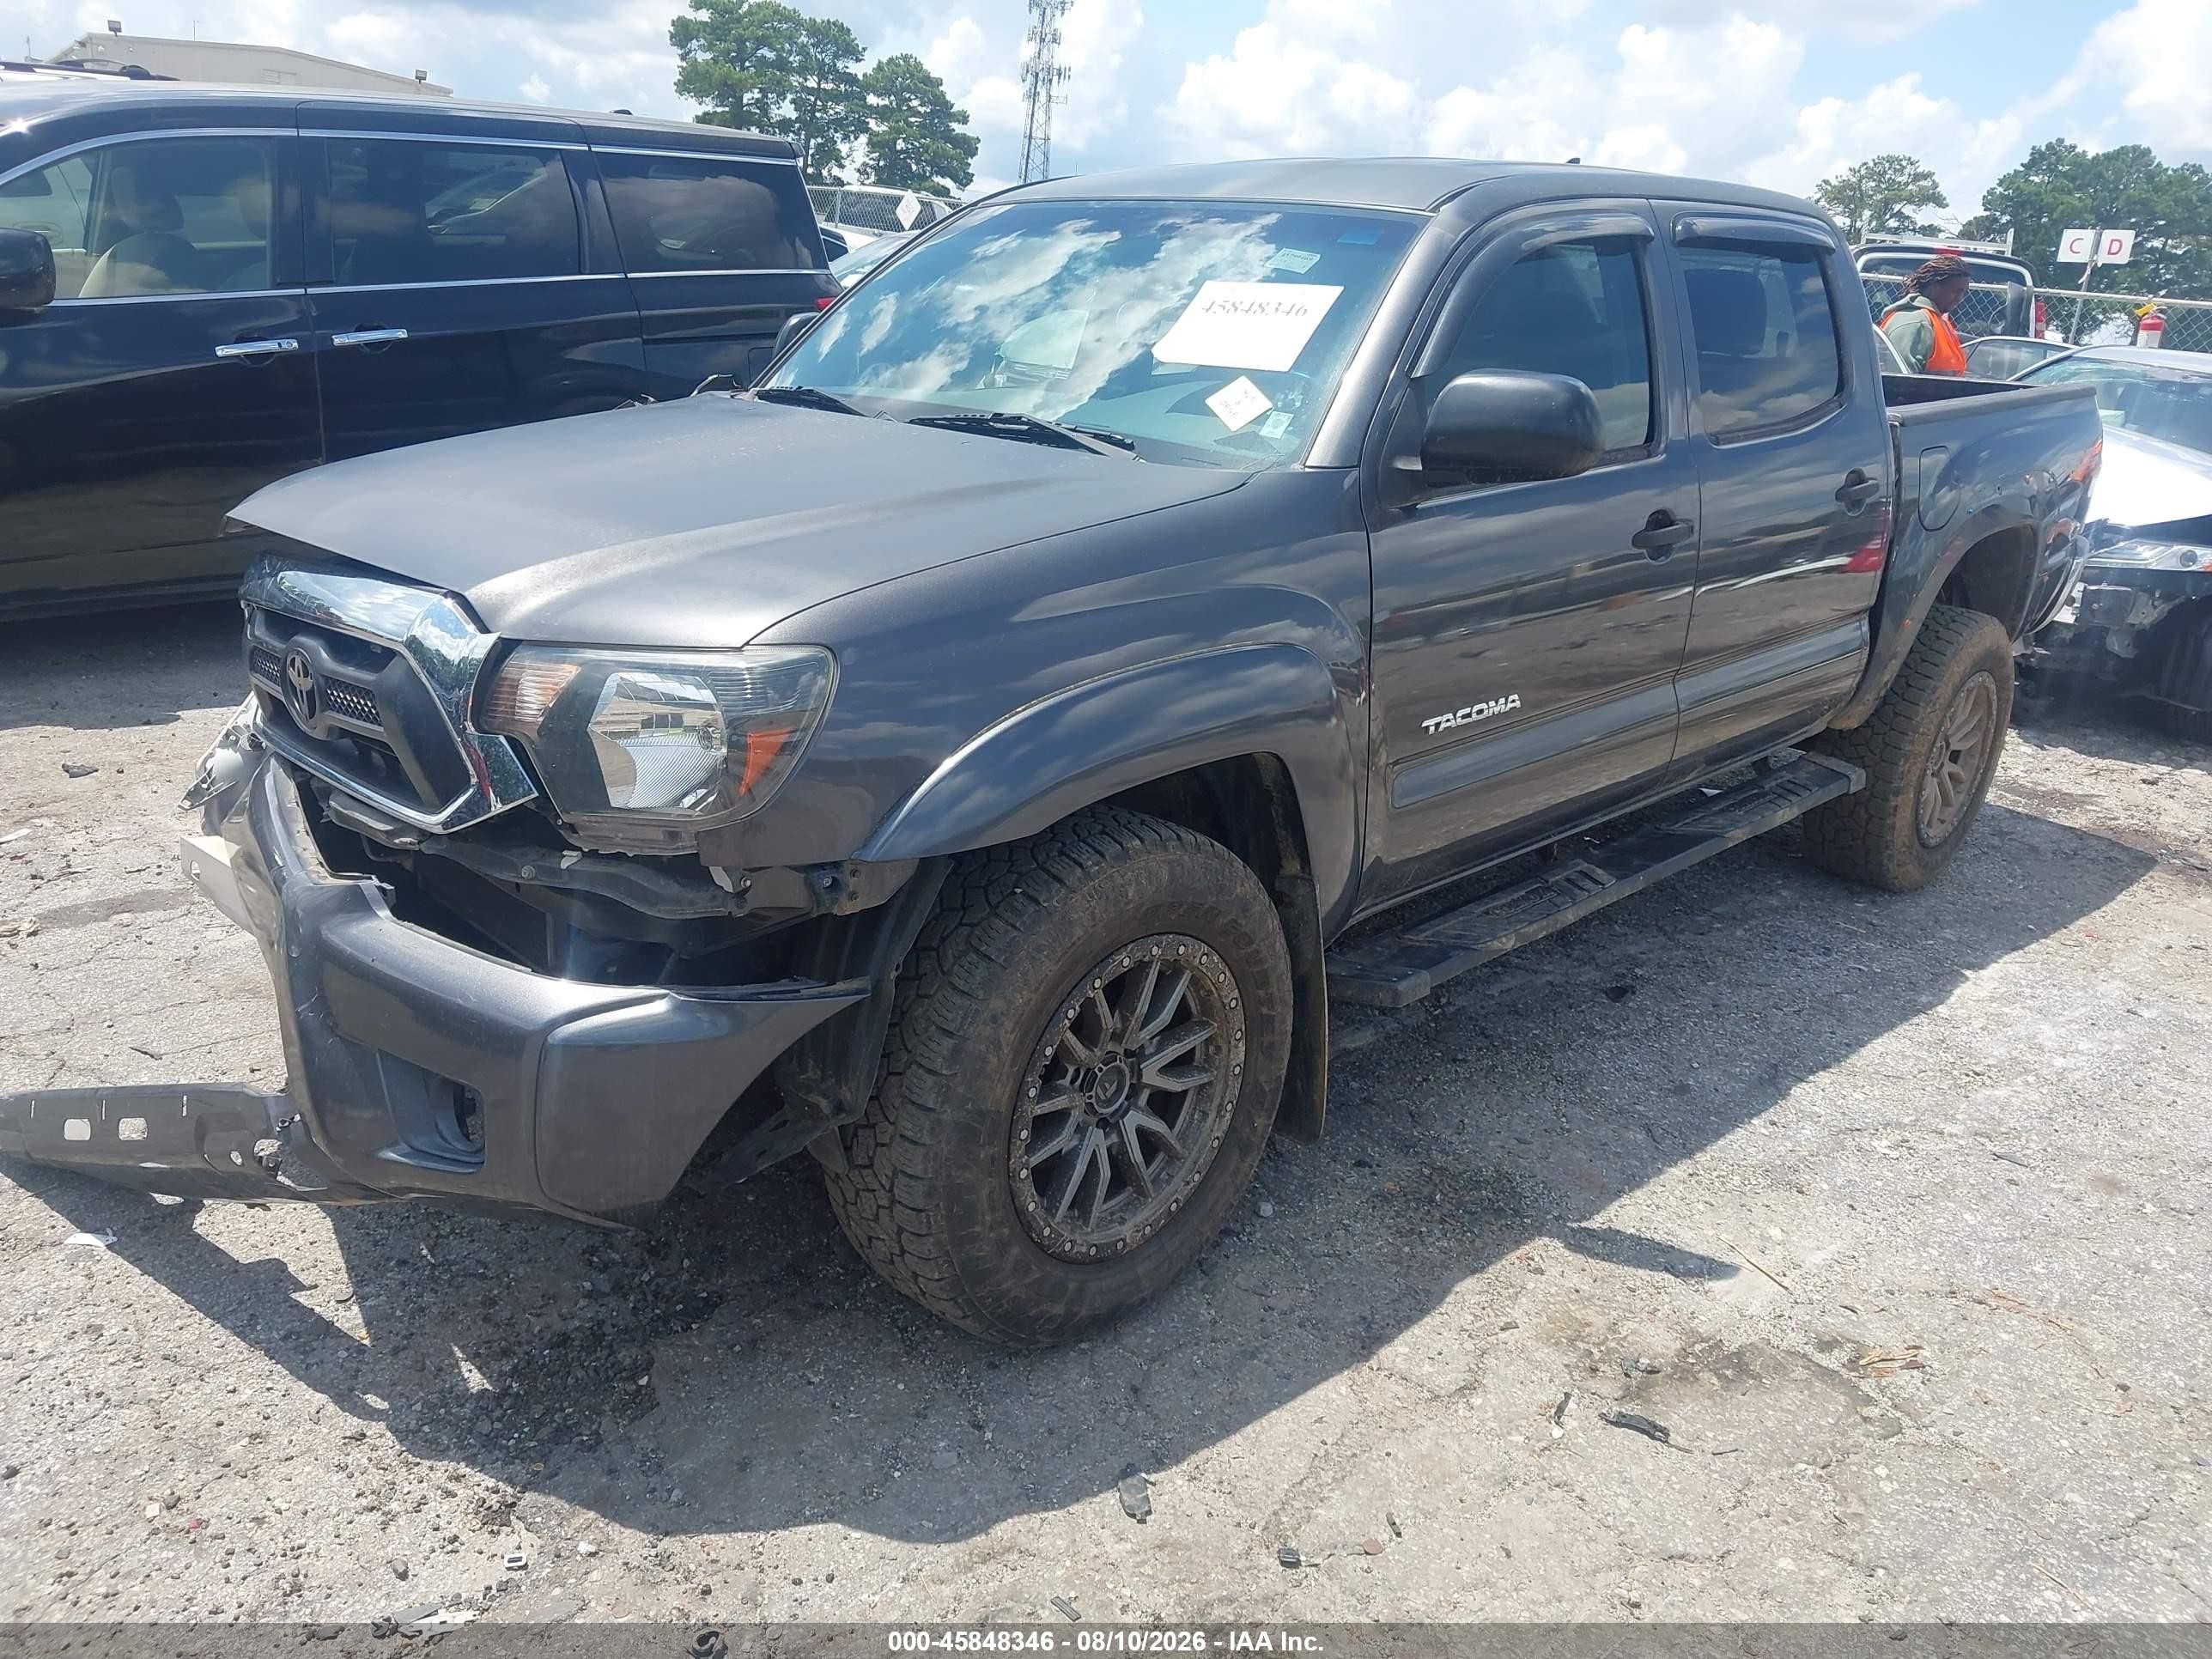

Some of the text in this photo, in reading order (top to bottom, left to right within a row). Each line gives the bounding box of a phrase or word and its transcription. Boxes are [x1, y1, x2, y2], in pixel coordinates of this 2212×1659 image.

[2069, 237, 2084, 254] C
[2106, 238, 2124, 256] D
[1421, 693, 1522, 735] TACOMA
